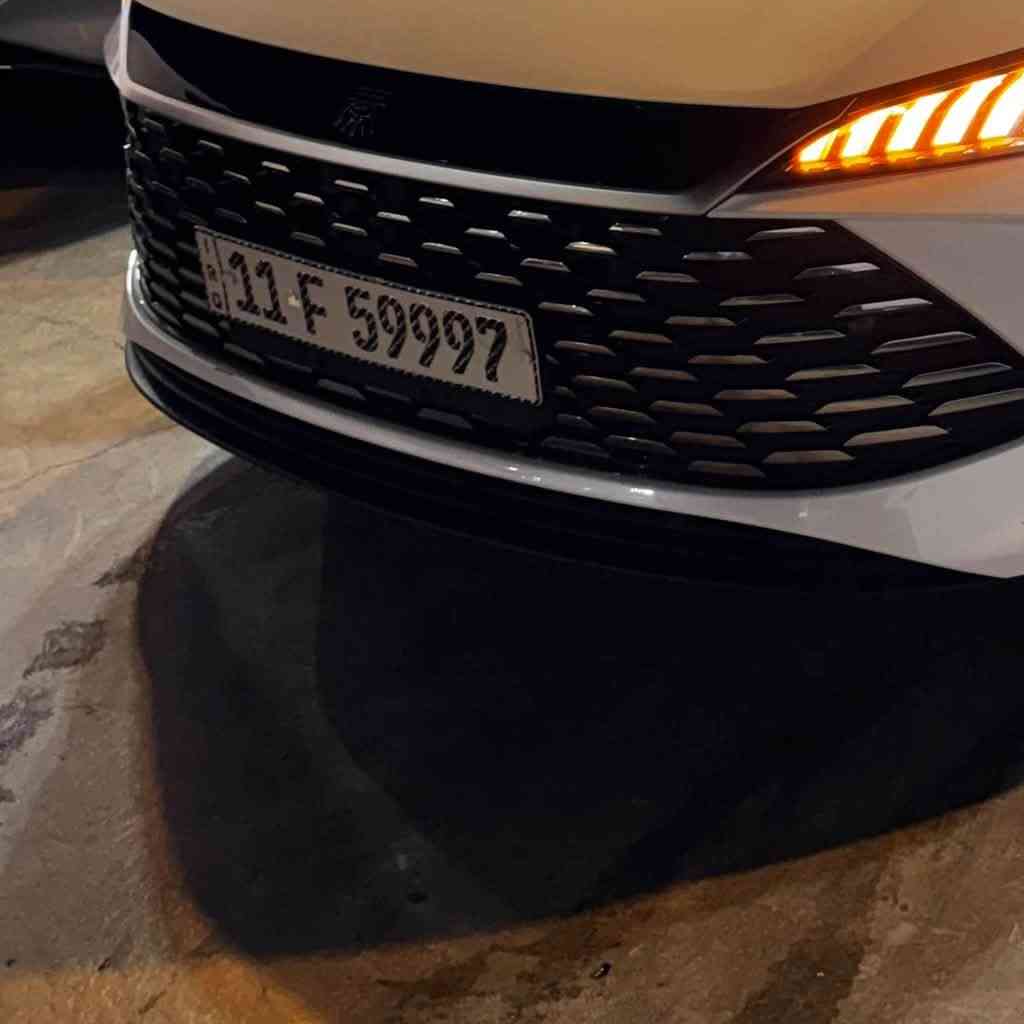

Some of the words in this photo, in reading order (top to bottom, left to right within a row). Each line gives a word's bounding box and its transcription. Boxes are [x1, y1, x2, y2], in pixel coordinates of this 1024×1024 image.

[228, 250, 288, 325] 11
[296, 271, 328, 335] F
[344, 285, 508, 383] 59997
